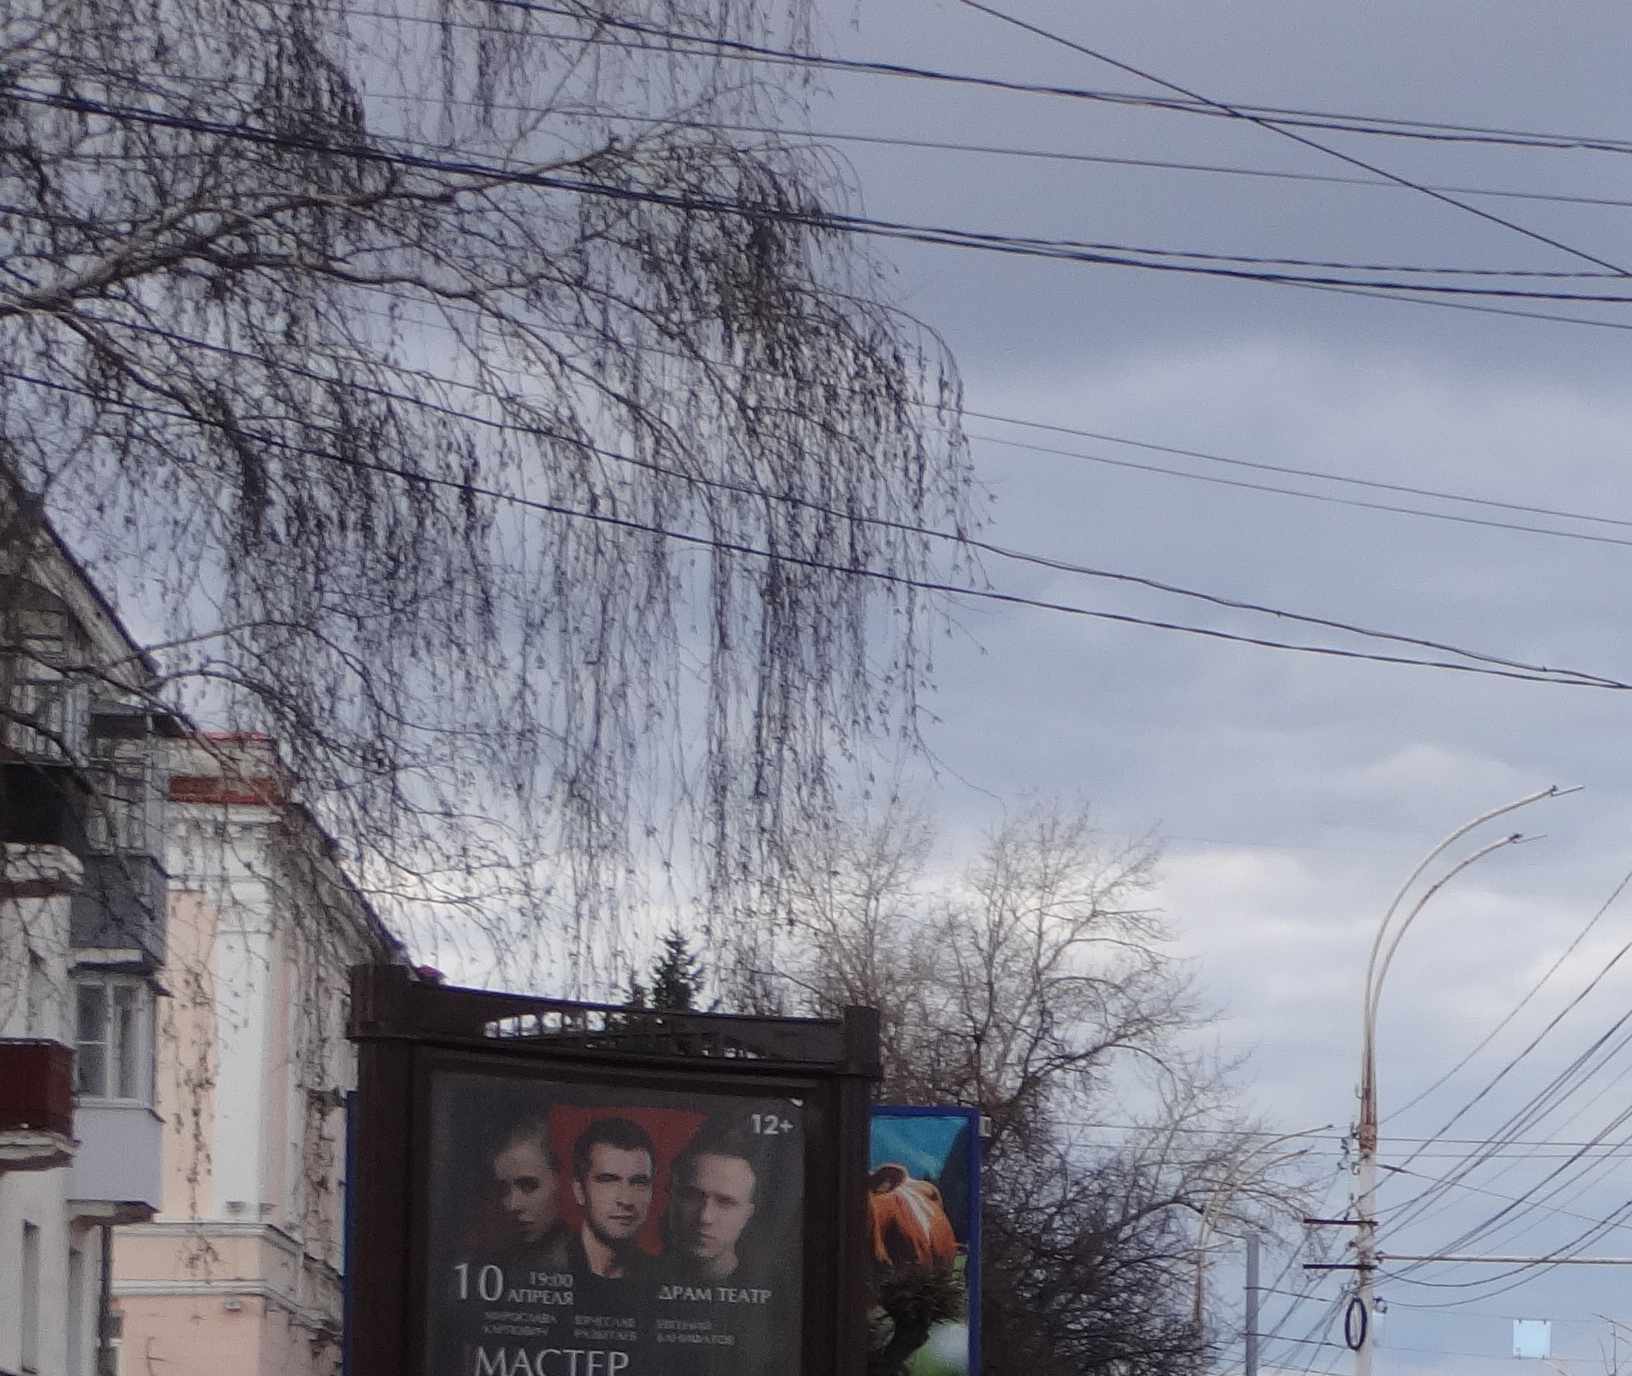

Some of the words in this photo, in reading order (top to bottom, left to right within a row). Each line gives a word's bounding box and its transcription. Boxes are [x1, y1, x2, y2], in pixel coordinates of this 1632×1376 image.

[751, 1113, 795, 1136] 12+
[454, 1262, 504, 1302] 10
[528, 1270, 574, 1288] 19:00
[507, 1288, 575, 1306] АПРЕЛЯ
[658, 1284, 713, 1302] ДРАМ
[717, 1287, 774, 1304] ТЕАТР
